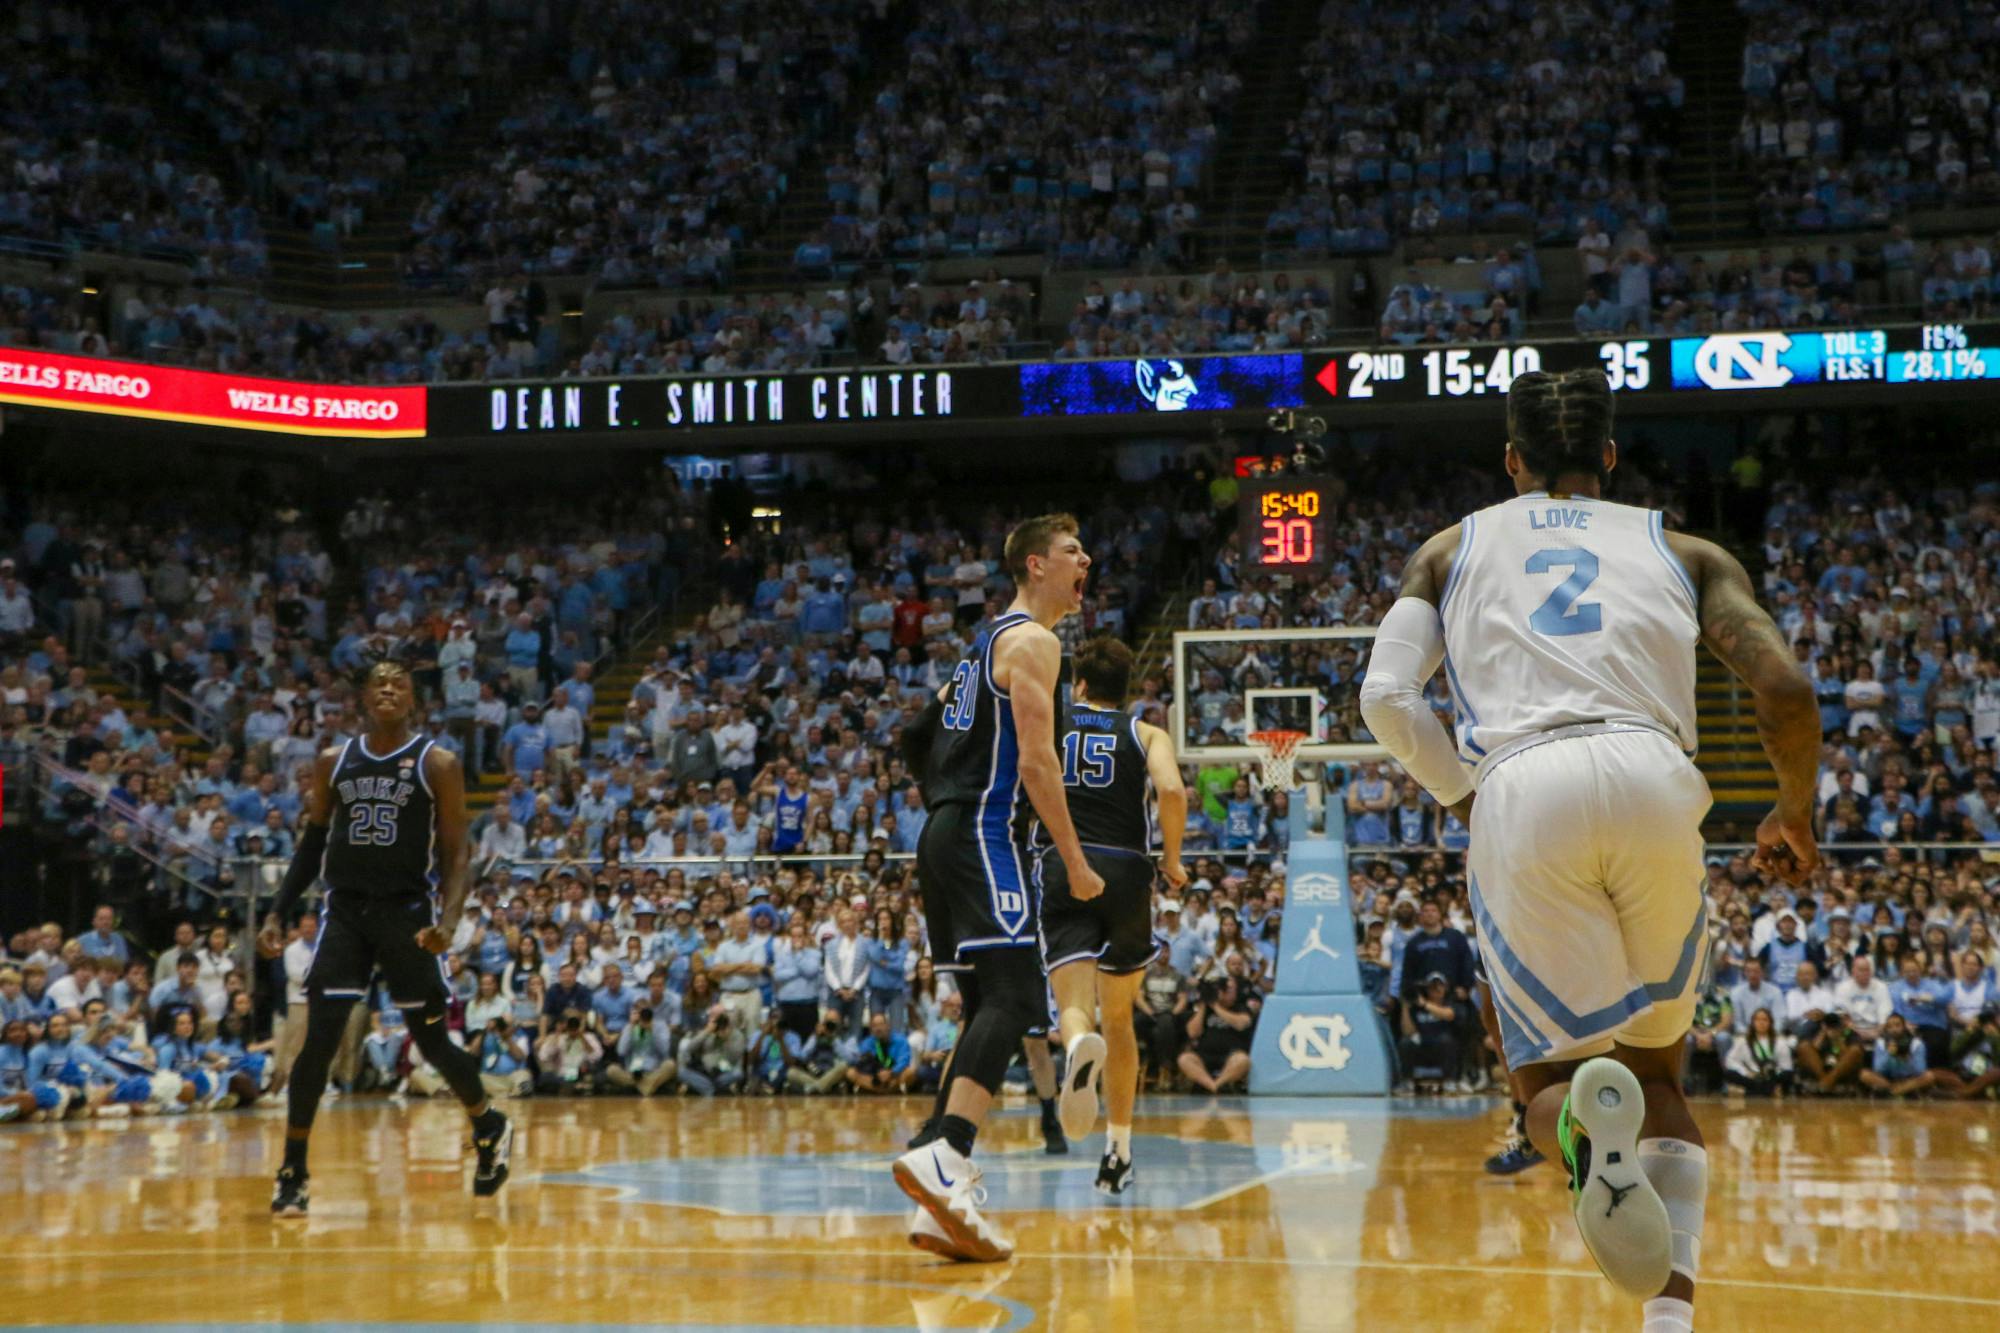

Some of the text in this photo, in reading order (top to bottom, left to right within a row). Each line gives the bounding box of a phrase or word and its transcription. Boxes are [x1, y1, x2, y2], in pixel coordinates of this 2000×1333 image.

[1822, 330, 1886, 356] TOL: 3
[1922, 324, 1968, 351] FG%
[1348, 351, 1406, 398] 2ND
[1423, 346, 1541, 396] 15:40
[1600, 341, 1650, 391] 35
[1825, 355, 1885, 381] FLS: 1
[1903, 348, 1987, 380] 28.1%
[65, 369, 151, 399] FARGO
[227, 388, 399, 421] WELLS FARGO
[491, 371, 953, 430] DEAN E. SMITH CENTER
[1261, 490, 1319, 518] 15:40
[1528, 508, 1593, 531] LOVE
[1262, 518, 1313, 564] 30
[1525, 548, 1602, 637] 2
[942, 659, 980, 731] 30
[1071, 713, 1115, 731] YOUNG
[1062, 730, 1117, 788] 15
[337, 776, 415, 807] DUKE
[349, 803, 399, 846] 25
[998, 891, 1022, 913] D
